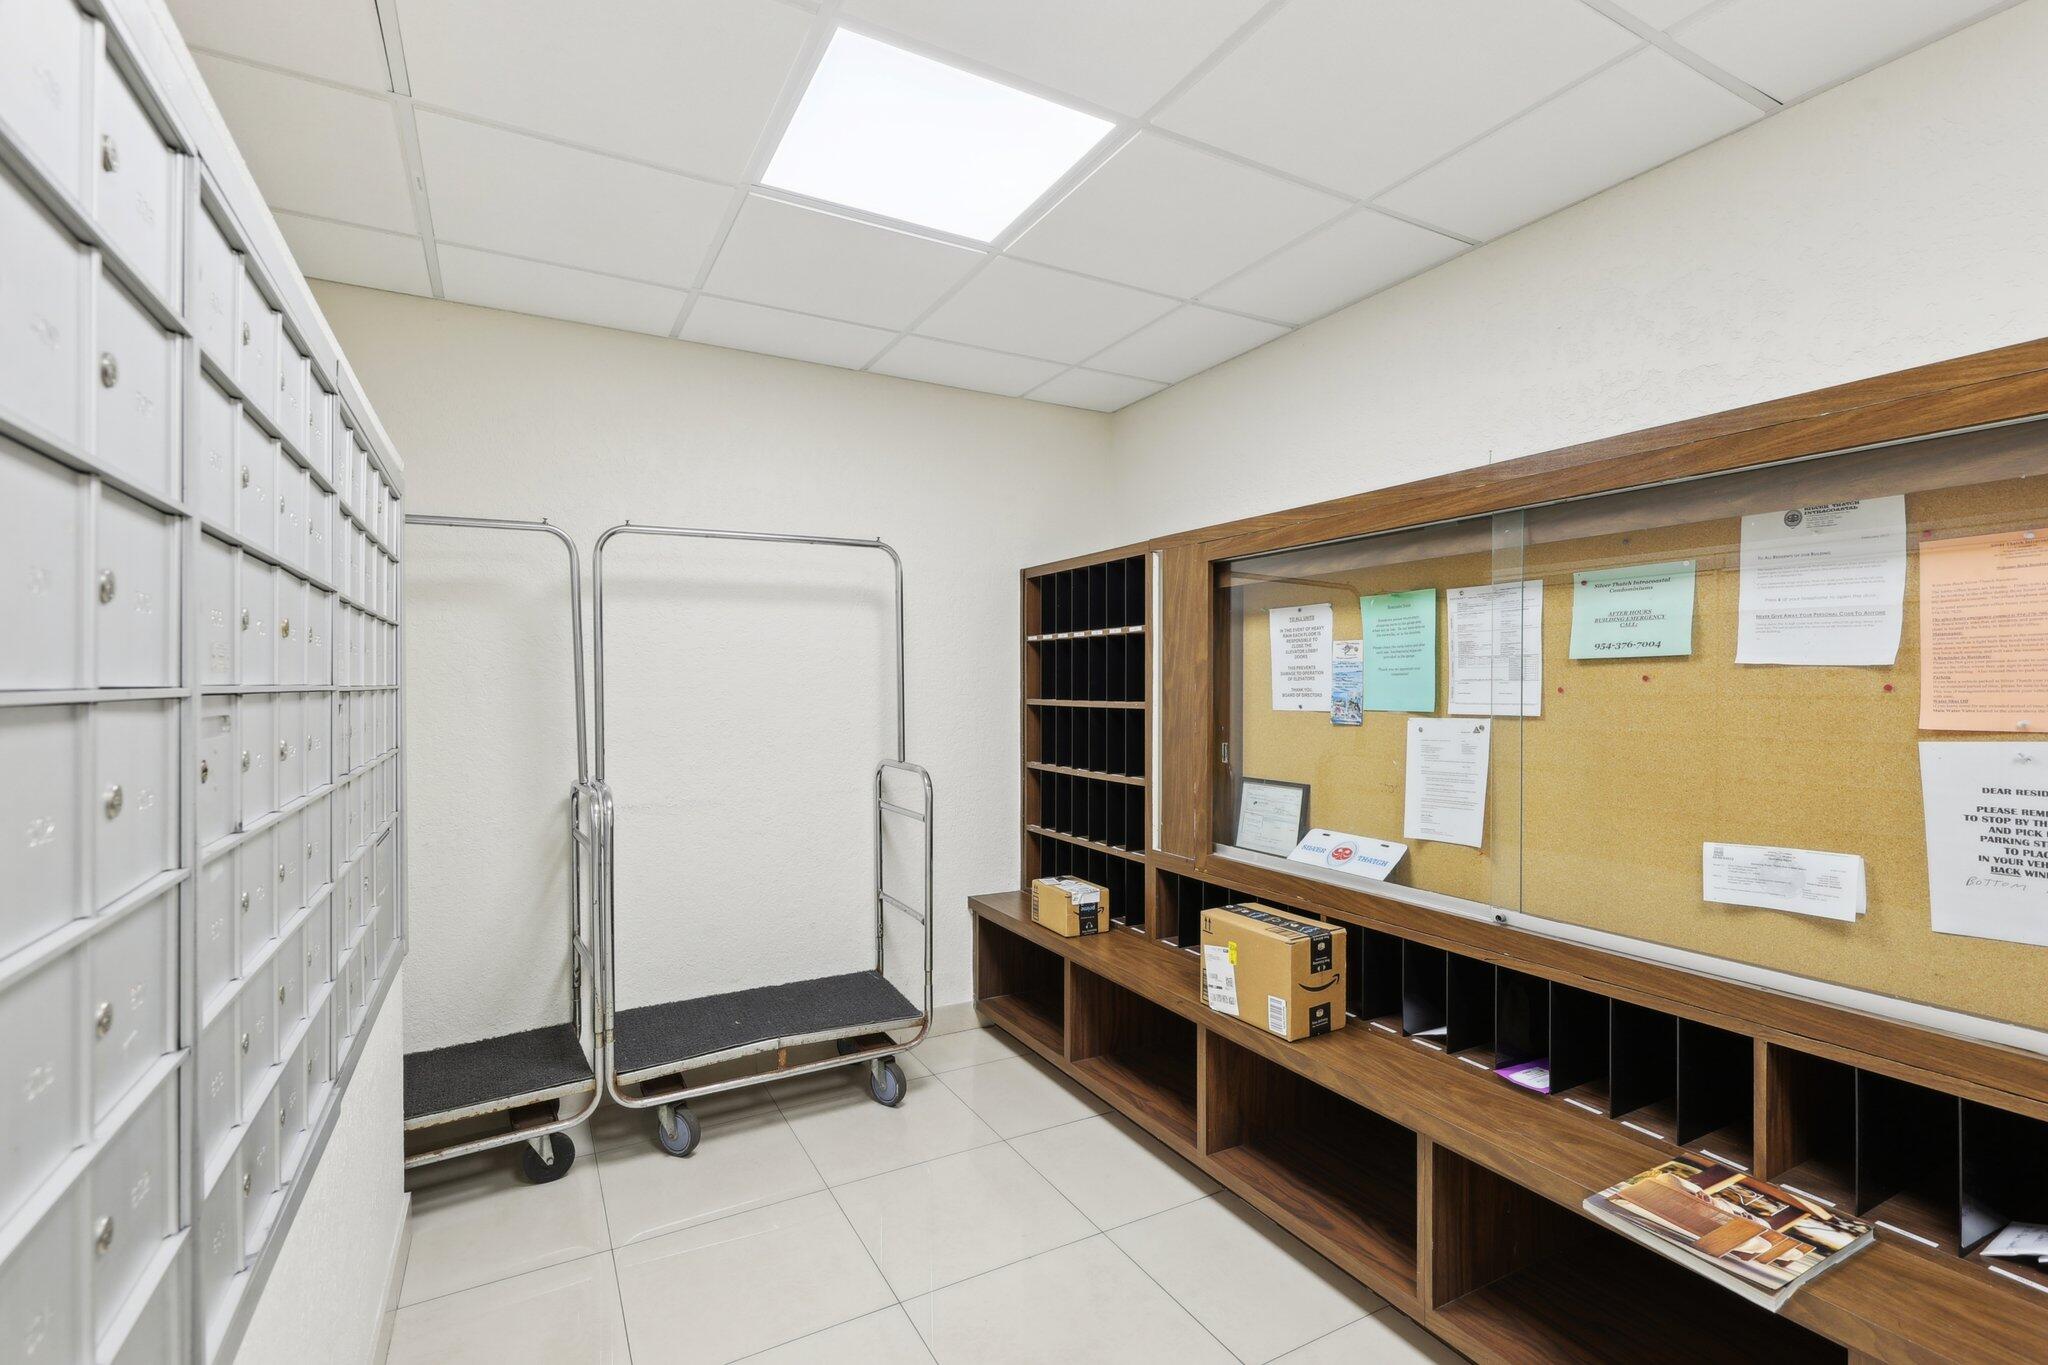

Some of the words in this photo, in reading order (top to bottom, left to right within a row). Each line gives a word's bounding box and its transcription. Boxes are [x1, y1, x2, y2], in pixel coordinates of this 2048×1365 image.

[1612, 580, 1632, 588] Thatch
[1633, 577, 1671, 586] Intracoastal
[1609, 586, 1653, 594] Condominiums
[1626, 614, 1665, 622] EMERGENCY
[1594, 641, 1662, 651] 954-376-7004
[1982, 787, 2012, 795] DEAR
[1976, 806, 2018, 816] PLEASE
[1964, 814, 1978, 822] TO
[1982, 816, 2012, 824] STOP
[2015, 818, 2030, 826] BY
[1988, 826, 2012, 835] AND
[2016, 828, 2042, 838] PICK
[1980, 836, 2030, 846] PARKING
[1302, 844, 1327, 854] SILVER
[2004, 847, 2019, 856] TO
[1357, 855, 1390, 867] THATCH
[1978, 855, 1990, 863] IN
[1993, 856, 2024, 866] YOUR
[1990, 866, 2022, 876] BACK
